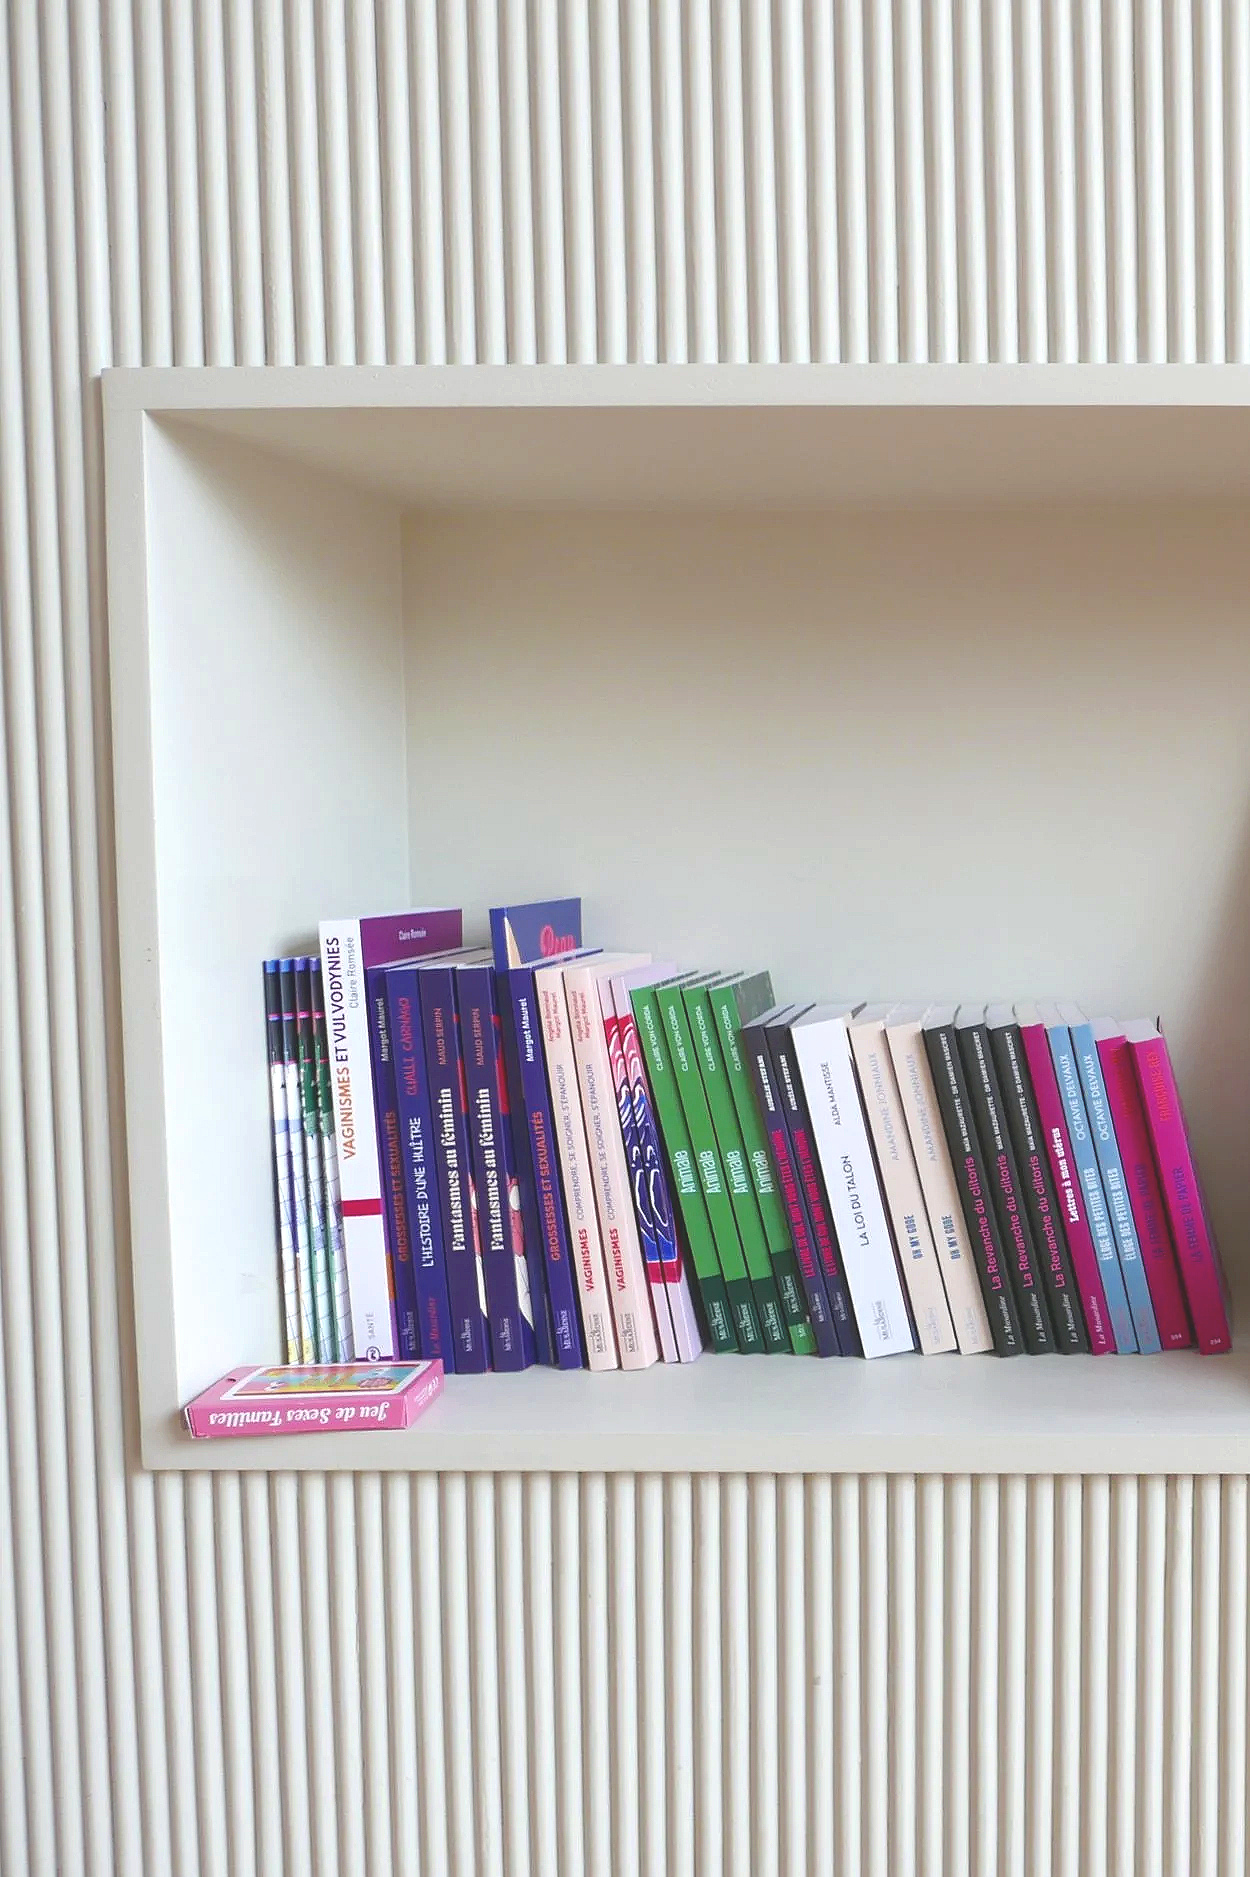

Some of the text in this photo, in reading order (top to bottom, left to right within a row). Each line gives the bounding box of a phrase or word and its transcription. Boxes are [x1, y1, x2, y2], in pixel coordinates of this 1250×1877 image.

[344, 938, 359, 1008] Claire Romsée
[327, 938, 355, 1159] VAGINISMES ET VULVODYNIES
[376, 998, 389, 1061] Margot Maurel
[519, 998, 534, 1061] Margot Maurel
[643, 1005, 663, 1071] CLAIRE VON CORDA
[668, 1005, 688, 1071] CLAIRE VON CORDA
[696, 1006, 706, 1030] CORDA
[721, 1005, 741, 1071] CLAIRE VON CORDA
[705, 1047, 715, 1071] CLAIRE
[821, 1063, 841, 1125] ALDA MANTISSE
[1060, 1055, 1085, 1140] OCTAVIE DELVAUX
[1084, 1055, 1109, 1141] OCTAVIE DELVAUX
[409, 1118, 434, 1266] L'HISTOIRE D'UNE HUÎTRE
[438, 1088, 465, 1250] Fantasmes au féminin
[476, 1089, 504, 1250] Fantasmes au féminin
[532, 1112, 560, 1261] GROSSESSES ET SEXUALITÉS
[674, 1151, 696, 1193] Animale
[699, 1151, 721, 1193] Animale
[726, 1151, 748, 1193] Animale
[750, 1151, 774, 1193] Animale
[841, 1156, 869, 1246] LA LOI DU TALON
[1052, 1128, 1079, 1222] Lettres à mon utérus
[909, 1236, 920, 1247] MY
[912, 1249, 923, 1259] OH
[964, 1157, 1001, 1289] La Revanche du clitoris
[996, 1155, 1033, 1287] La Revanche du clitoris
[1029, 1156, 1065, 1287] La Revanche du clitoris
[578, 1229, 594, 1291] VAGINISMES
[610, 1229, 625, 1291] VAGINISMES
[209, 1401, 390, 1427] Jeu de Sexes Familles
